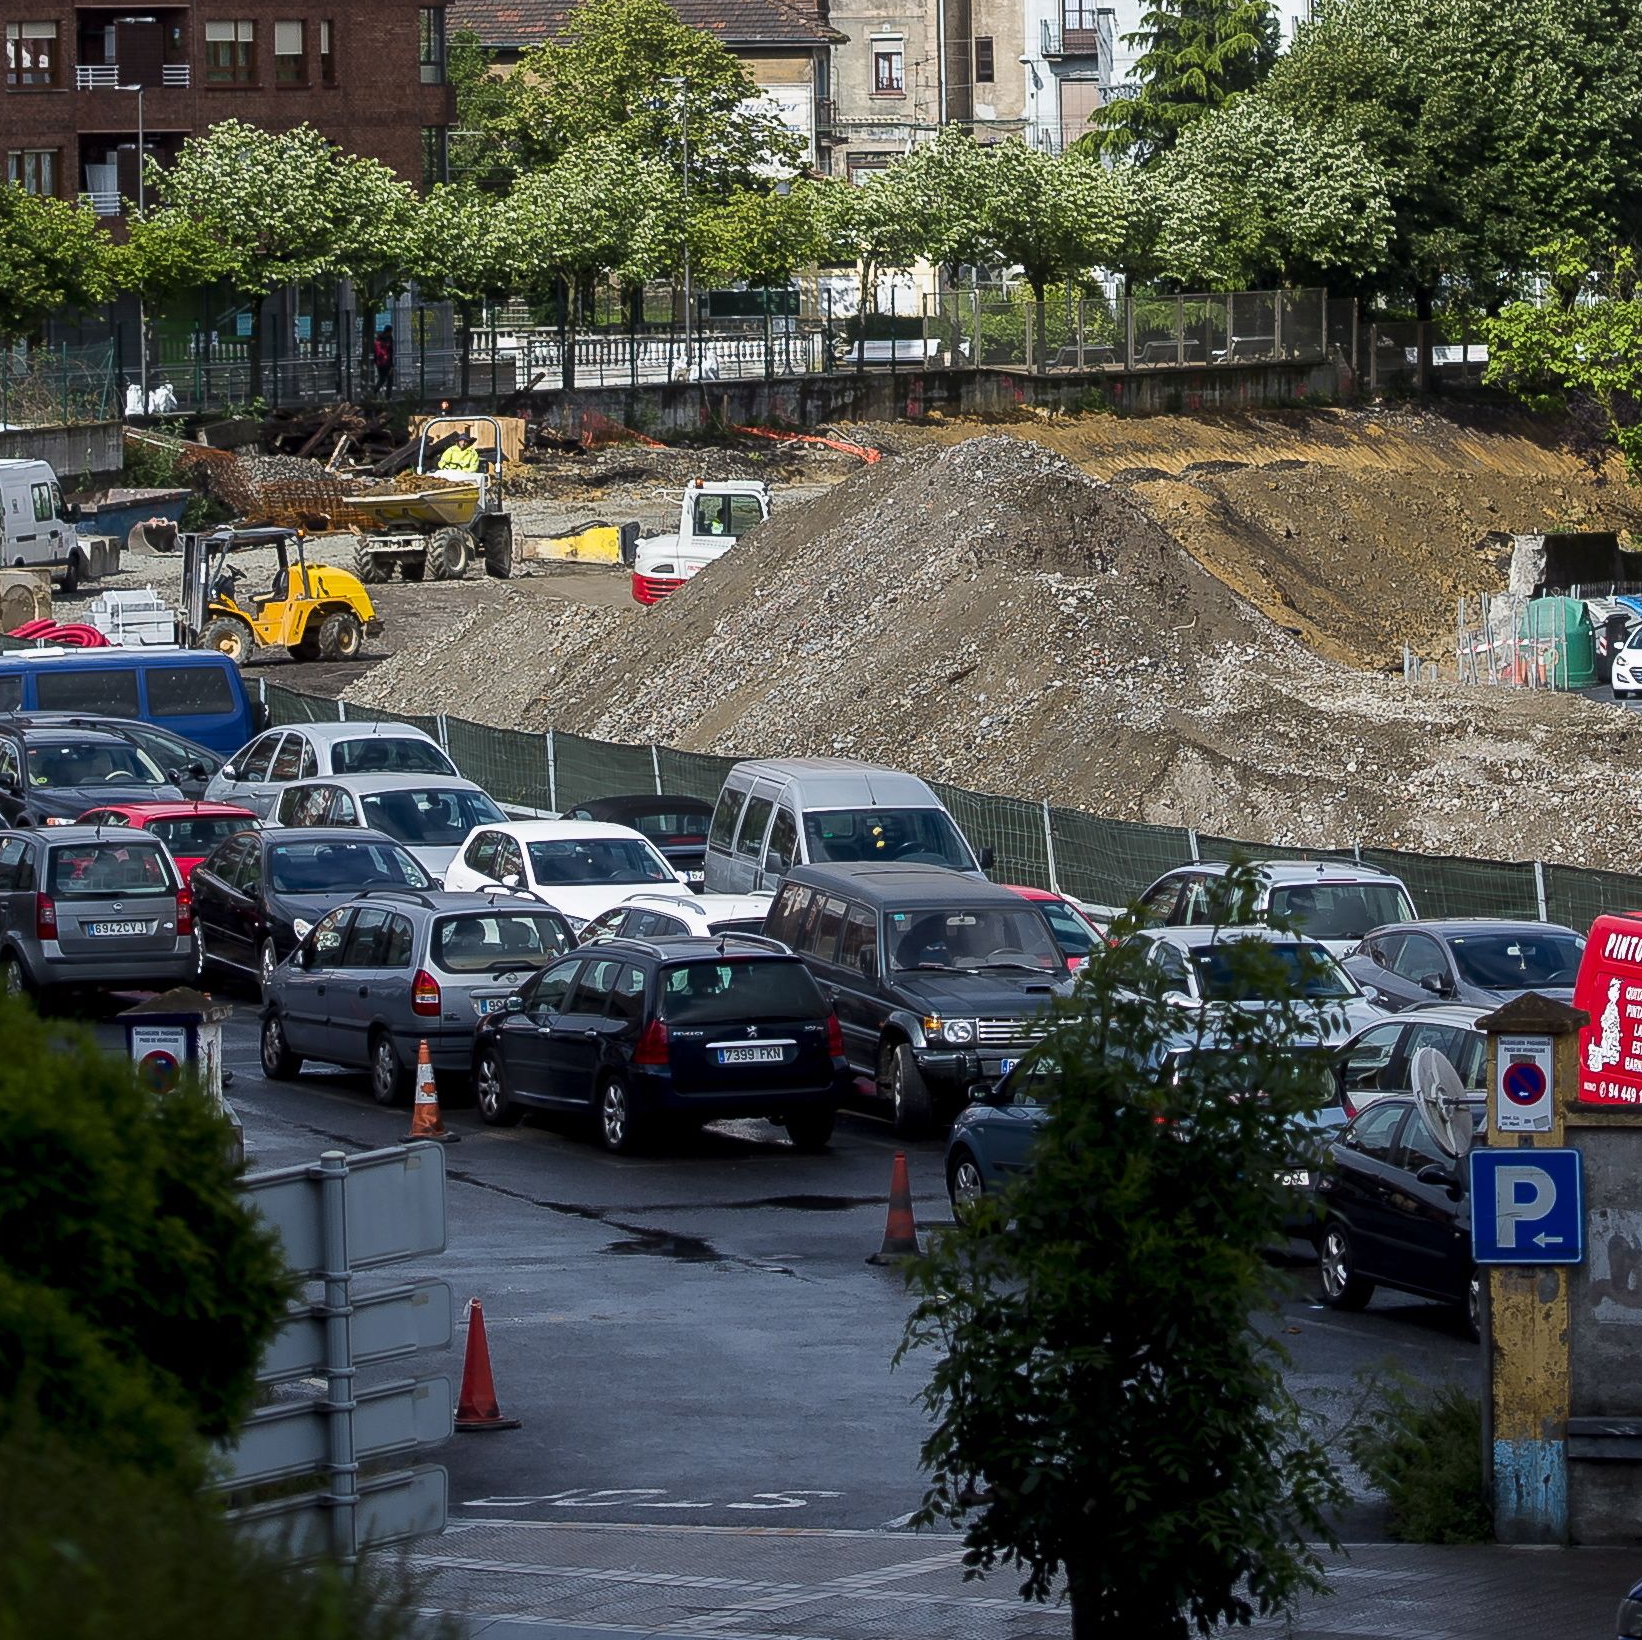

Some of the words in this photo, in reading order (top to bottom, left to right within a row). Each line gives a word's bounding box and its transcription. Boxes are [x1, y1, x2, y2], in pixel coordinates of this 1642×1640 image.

[725, 1048, 756, 1062] 7399
[760, 1047, 782, 1060] FKN
[1608, 1082, 1619, 1099] 94
[1620, 1085, 1637, 1103] 449
[1495, 1165, 1557, 1248] P
